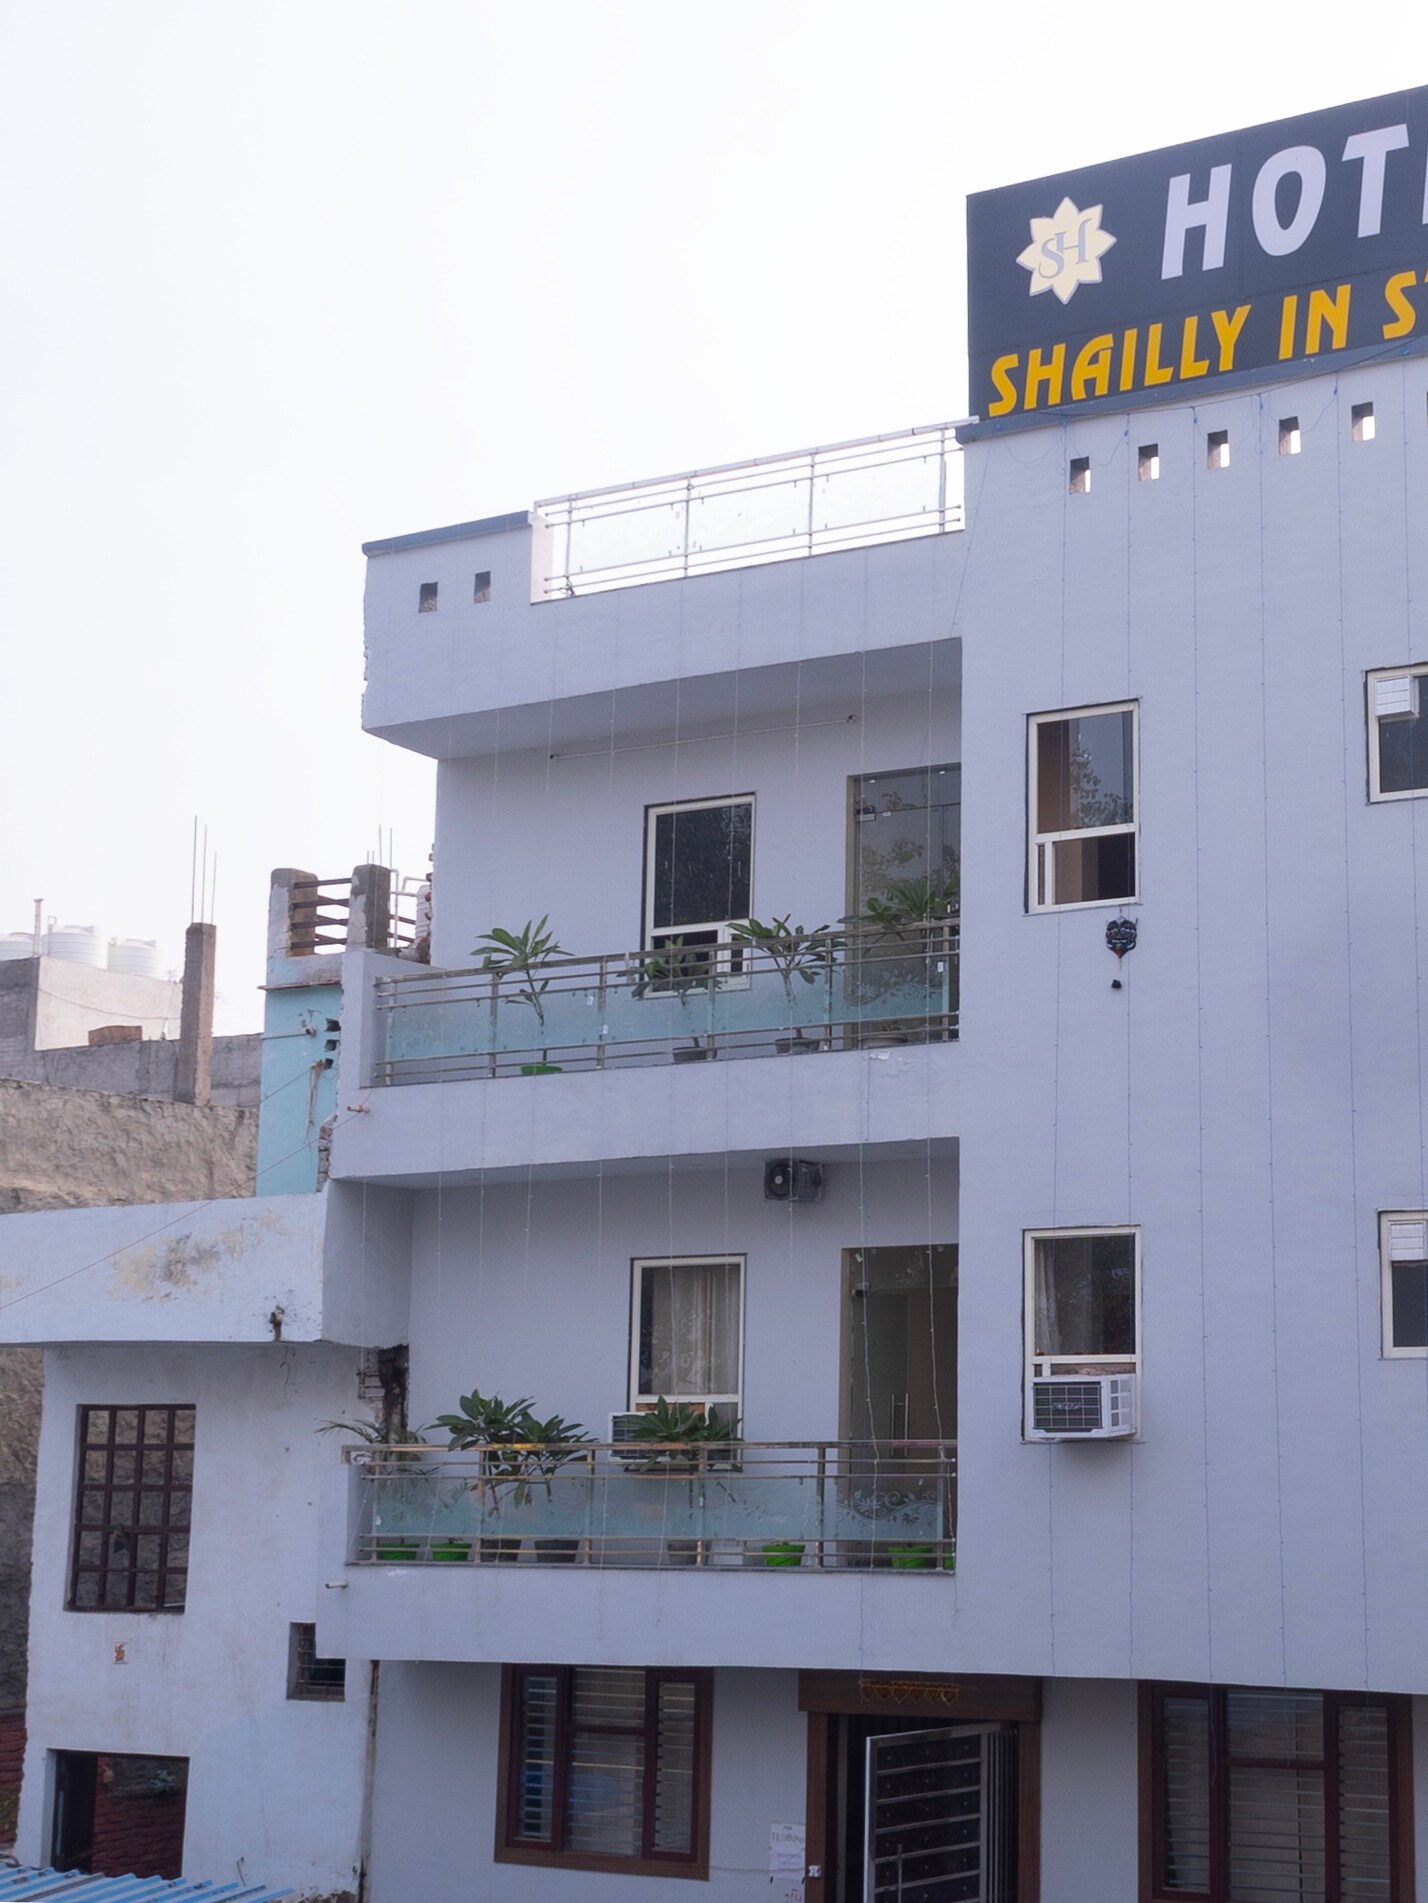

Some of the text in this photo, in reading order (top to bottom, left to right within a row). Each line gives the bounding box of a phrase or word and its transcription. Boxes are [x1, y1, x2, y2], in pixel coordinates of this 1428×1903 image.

[1038, 218, 1092, 279] SH
[988, 304, 1251, 417] SHAILLY
[1278, 284, 1351, 360] IN
